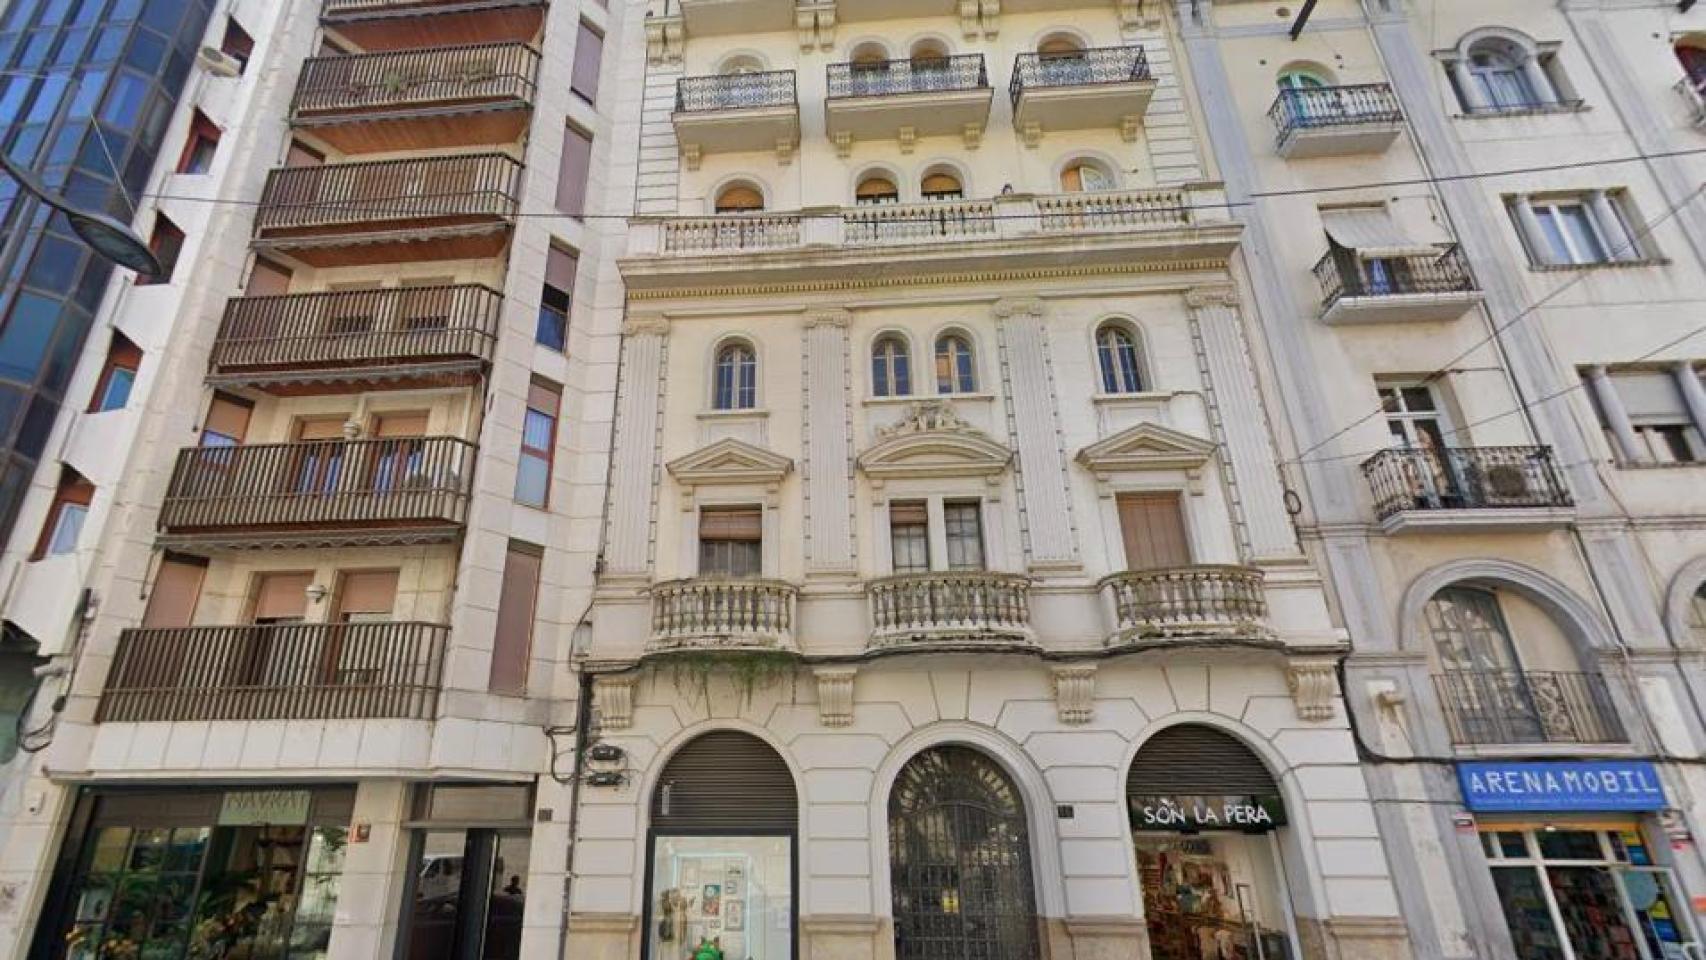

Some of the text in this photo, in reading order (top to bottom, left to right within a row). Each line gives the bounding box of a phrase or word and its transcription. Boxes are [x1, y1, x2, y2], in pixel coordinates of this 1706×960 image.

[1471, 770, 1659, 793] ARENAMOBIL
[1193, 804, 1220, 824] LA
[1223, 804, 1272, 824] PERA
